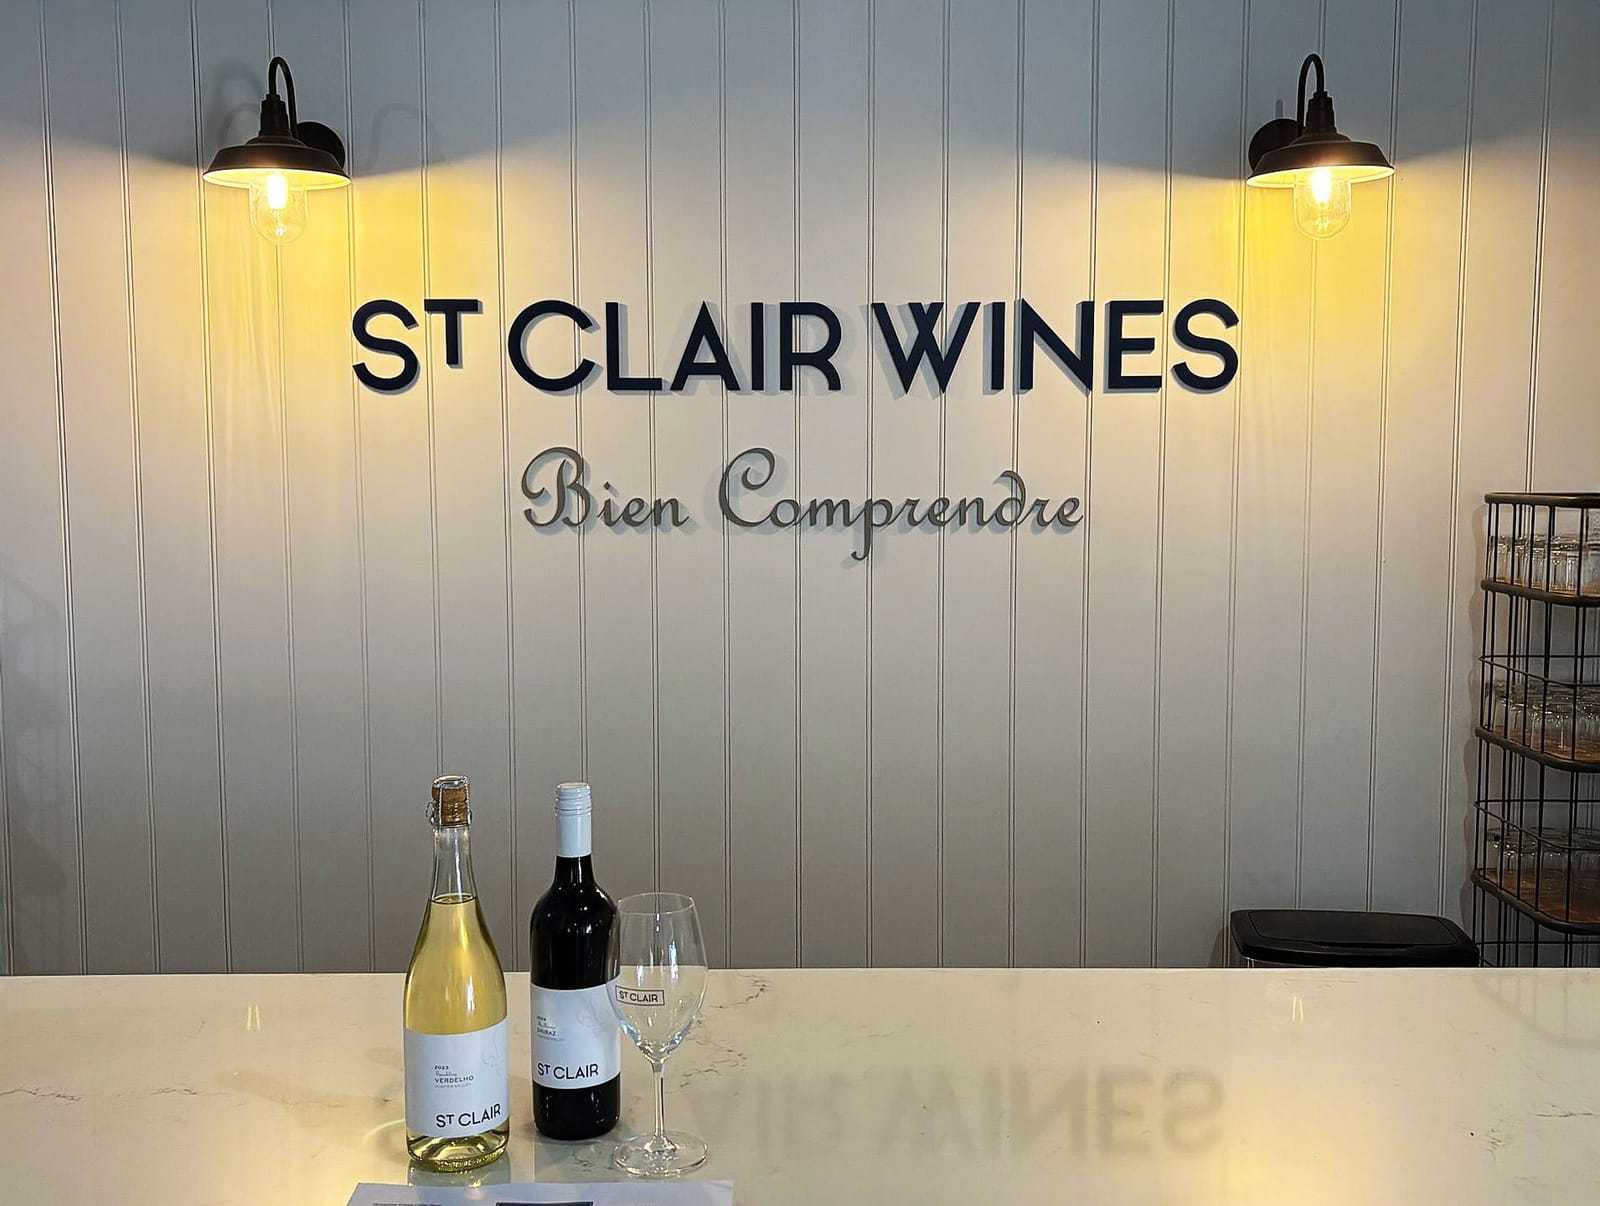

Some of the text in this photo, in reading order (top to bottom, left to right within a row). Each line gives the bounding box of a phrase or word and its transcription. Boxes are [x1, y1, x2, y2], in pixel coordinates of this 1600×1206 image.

[352, 298, 1240, 394] ST CLAIR WINES
[521, 446, 1084, 560] Bien Comprendre
[619, 990, 659, 1003] ST CLAIR
[434, 1074, 474, 1084] VERDELHO
[537, 1061, 599, 1080] ST CLAIR
[435, 1103, 501, 1128] ST CLAIR
